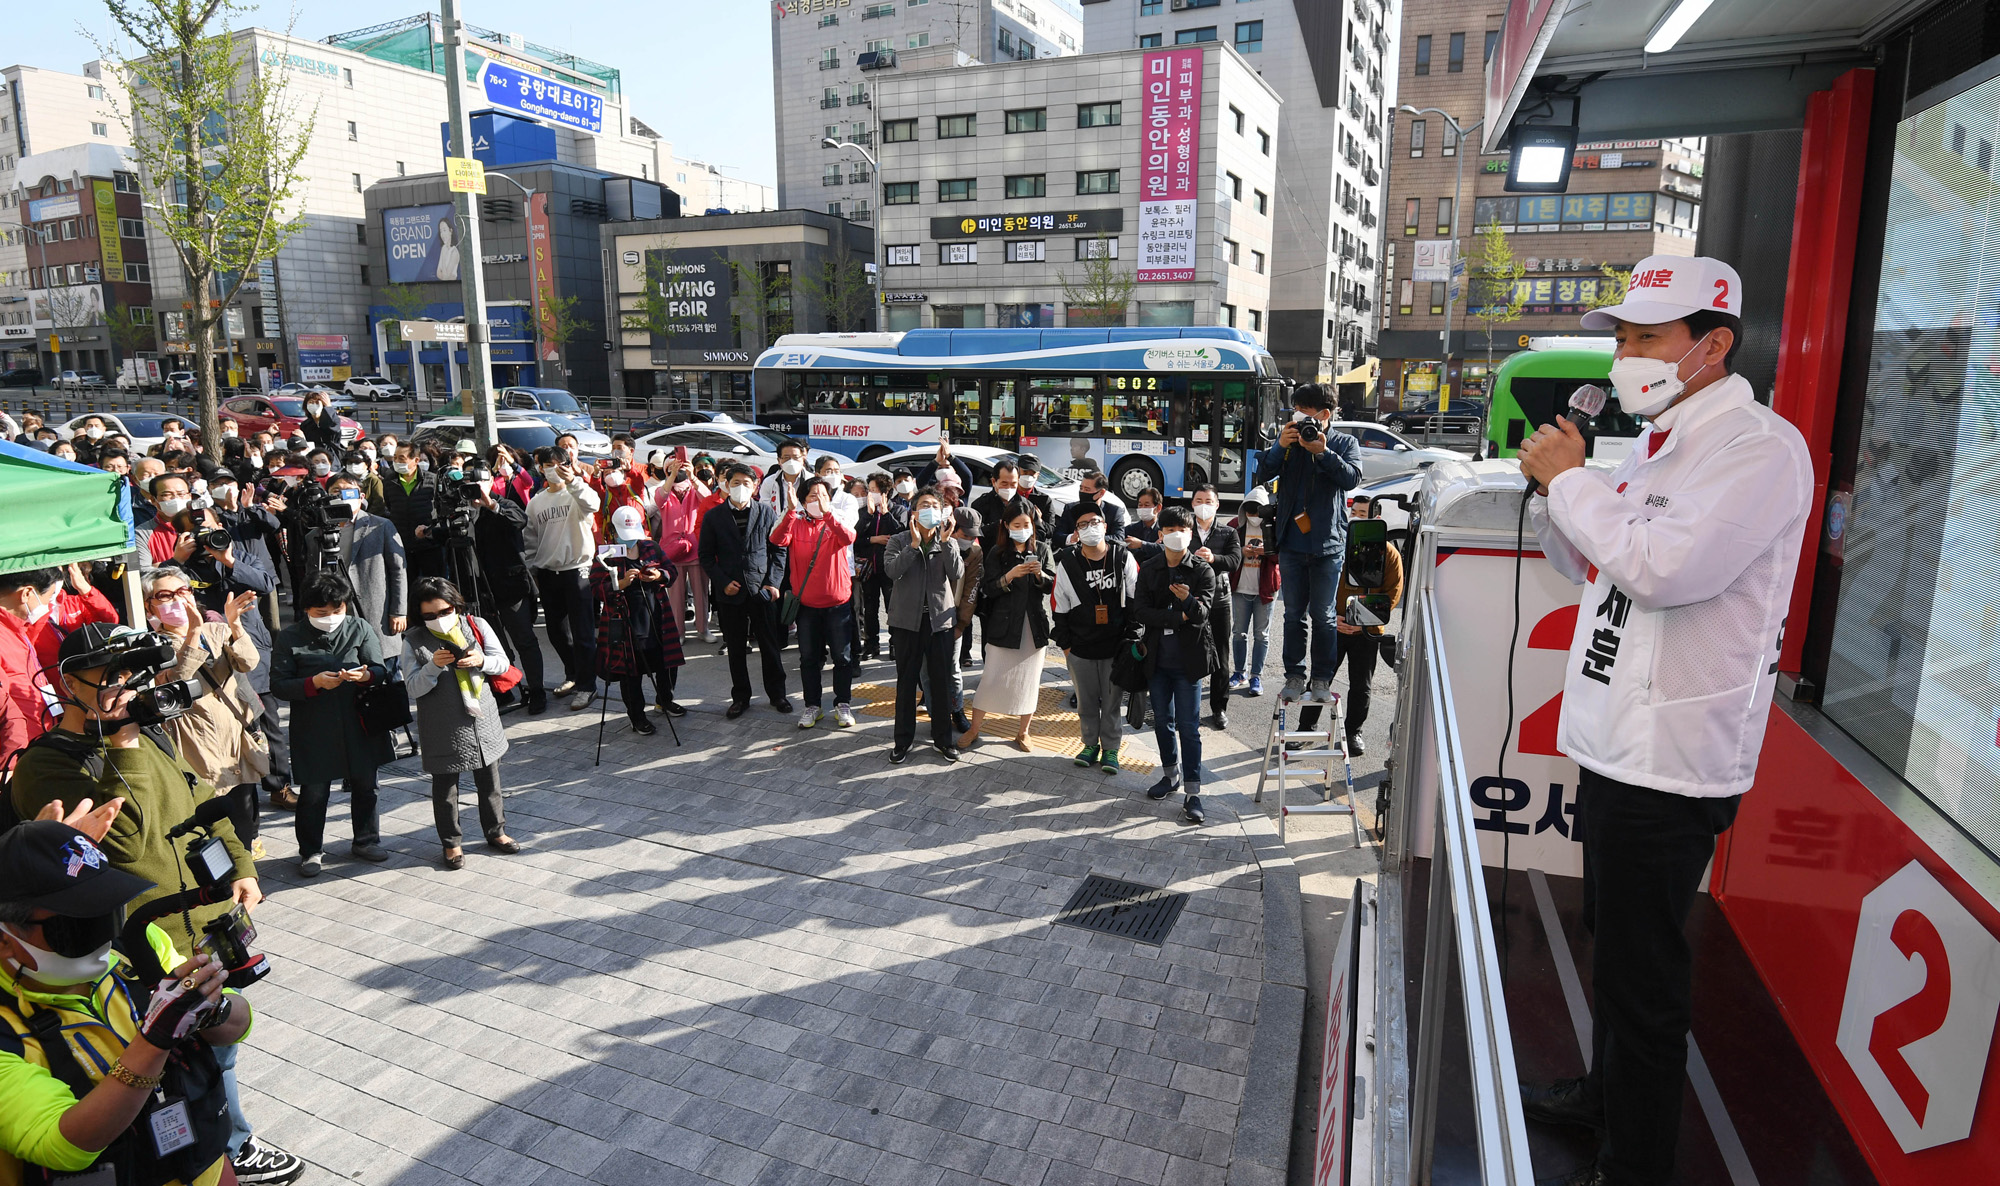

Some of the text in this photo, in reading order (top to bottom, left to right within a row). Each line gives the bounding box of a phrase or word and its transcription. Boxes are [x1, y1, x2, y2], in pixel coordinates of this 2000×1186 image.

[517, 75, 601, 118] 공항대로61길
[520, 99, 600, 131] Gonghang-daero 61-gil
[1148, 56, 1171, 197] 미인동안의원
[1175, 204, 1191, 214] 필러
[1527, 195, 1651, 219] 1톤 차주 모집
[406, 214, 431, 224] 그랜드오픈
[978, 215, 1054, 232] 미인동안의원
[1067, 214, 1079, 222] 3F
[1151, 217, 1184, 228] 윤곽주사
[390, 224, 432, 242] GRAND
[1142, 230, 1193, 240] 슈링크 리프팅
[392, 243, 427, 260] OPEN
[1146, 242, 1187, 253] 동안클리닉
[953, 253, 965, 261] 필러
[1018, 251, 1035, 259] 리프팅
[1146, 255, 1187, 264] 피부클리닉
[667, 264, 706, 274] SIMMONS
[1139, 272, 1193, 280] 02.2651.3407
[1628, 269, 1674, 292] 오세훈
[536, 247, 550, 323] SALE
[659, 280, 716, 298] LIVING
[1559, 280, 1599, 301] 창업
[886, 292, 925, 303] 댄스스포츠
[1712, 278, 1729, 309] 2
[668, 300, 708, 317] FAIR
[691, 324, 703, 332] 가격
[704, 323, 717, 333] 할인
[703, 351, 749, 361] SIMMONS
[784, 353, 812, 366] EV
[1147, 350, 1191, 358] 전기버스 타고
[1167, 360, 1214, 368] 숨 쉬는 서울로
[1117, 377, 1156, 390] 602
[813, 424, 870, 437] WALK FIRST
[1085, 568, 1106, 582] JUST
[1868, 909, 1951, 1130] 2
